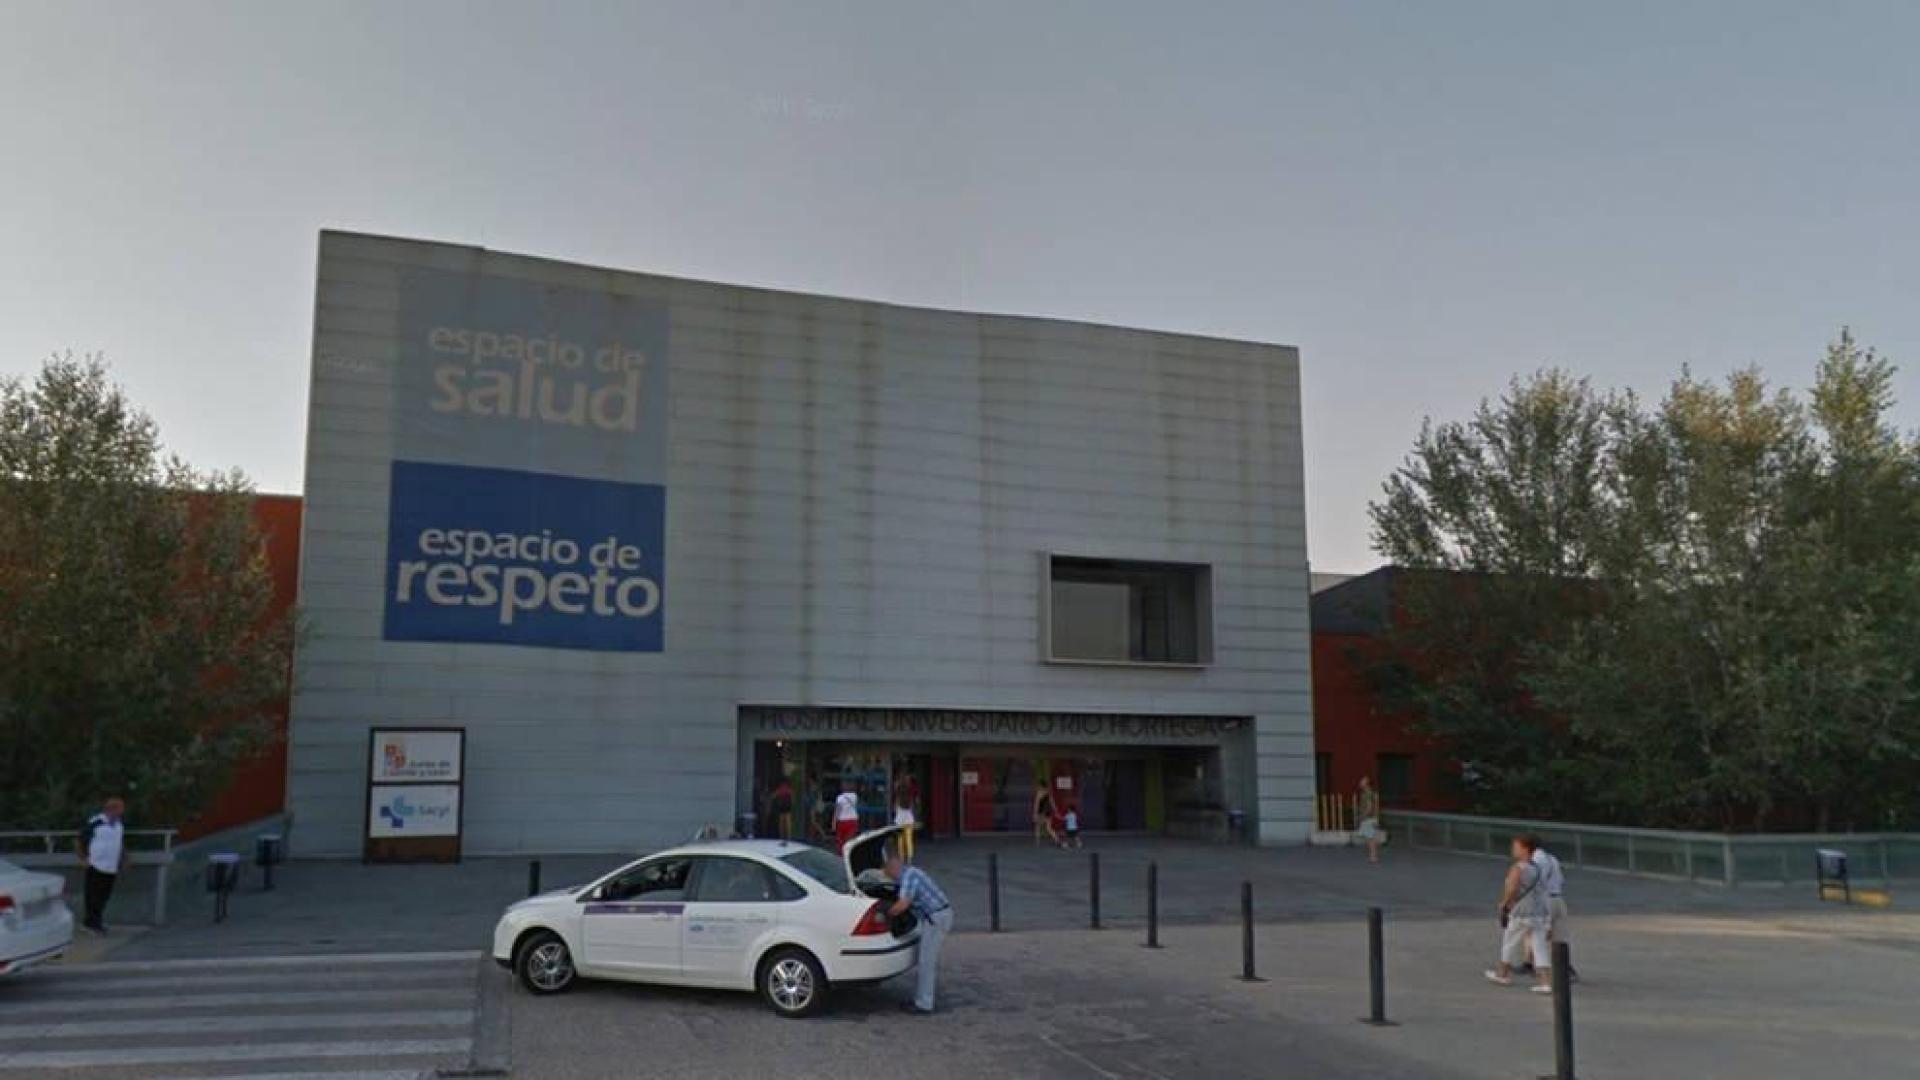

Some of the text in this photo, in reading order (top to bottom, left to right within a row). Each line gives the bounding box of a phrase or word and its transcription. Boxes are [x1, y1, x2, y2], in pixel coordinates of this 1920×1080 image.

[429, 326, 584, 368] espacio
[595, 341, 646, 373] de
[430, 360, 642, 432] salud
[418, 527, 642, 570] espacio de
[396, 559, 661, 625] respeto
[759, 709, 873, 732] HOSPITAL
[883, 710, 1055, 736] UNIVERSITARIO
[1109, 714, 1217, 738] HORTEGA
